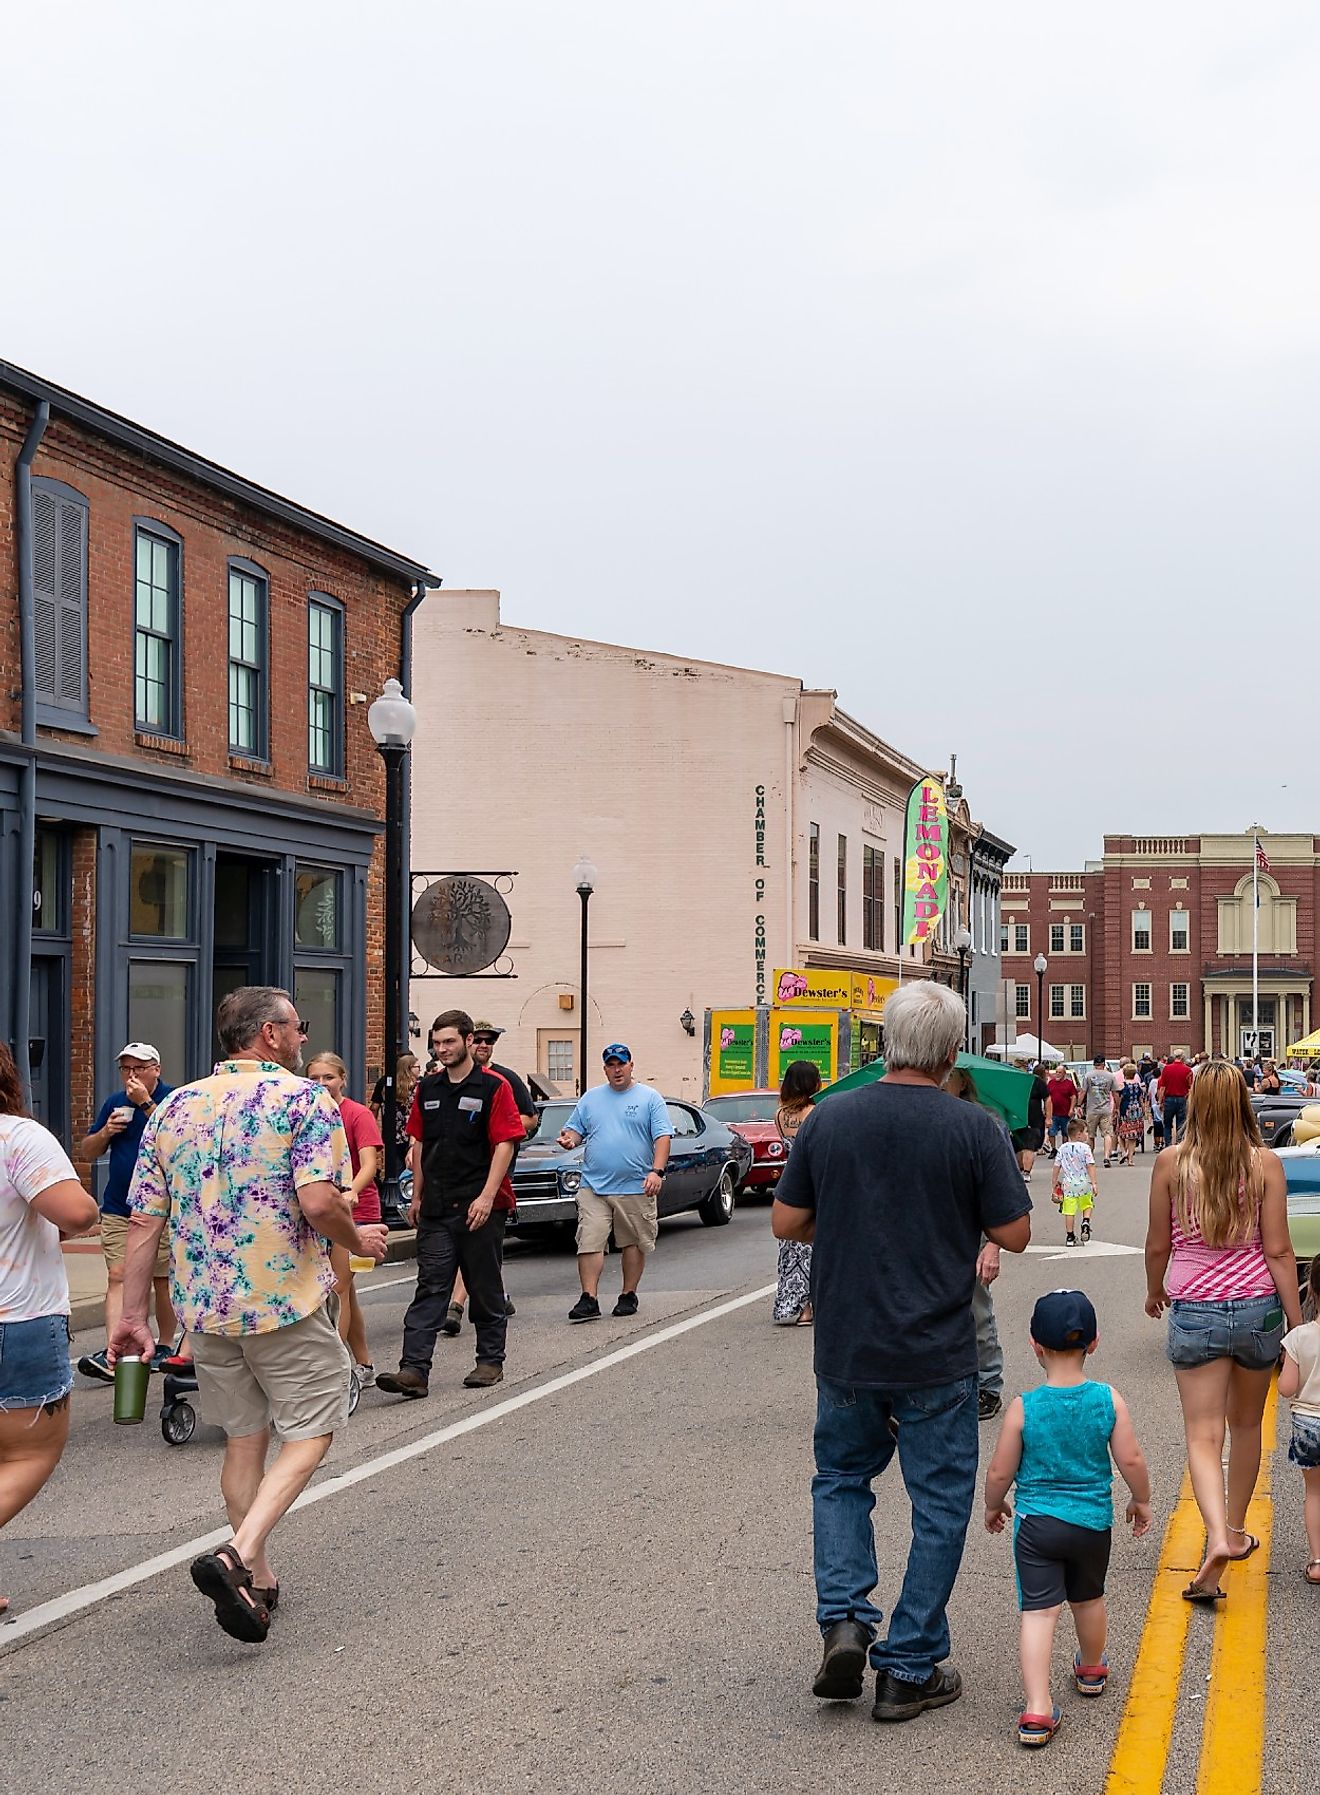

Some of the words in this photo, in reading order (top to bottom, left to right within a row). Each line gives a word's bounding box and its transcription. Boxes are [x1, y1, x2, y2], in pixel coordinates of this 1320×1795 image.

[755, 785, 765, 866] CHAMBER
[915, 787, 942, 937] LEMONADE
[755, 879, 765, 901] OF
[755, 915, 765, 1006] COMMERCE
[794, 986, 848, 999] Dewster's
[791, 1038, 831, 1046] Dewster's
